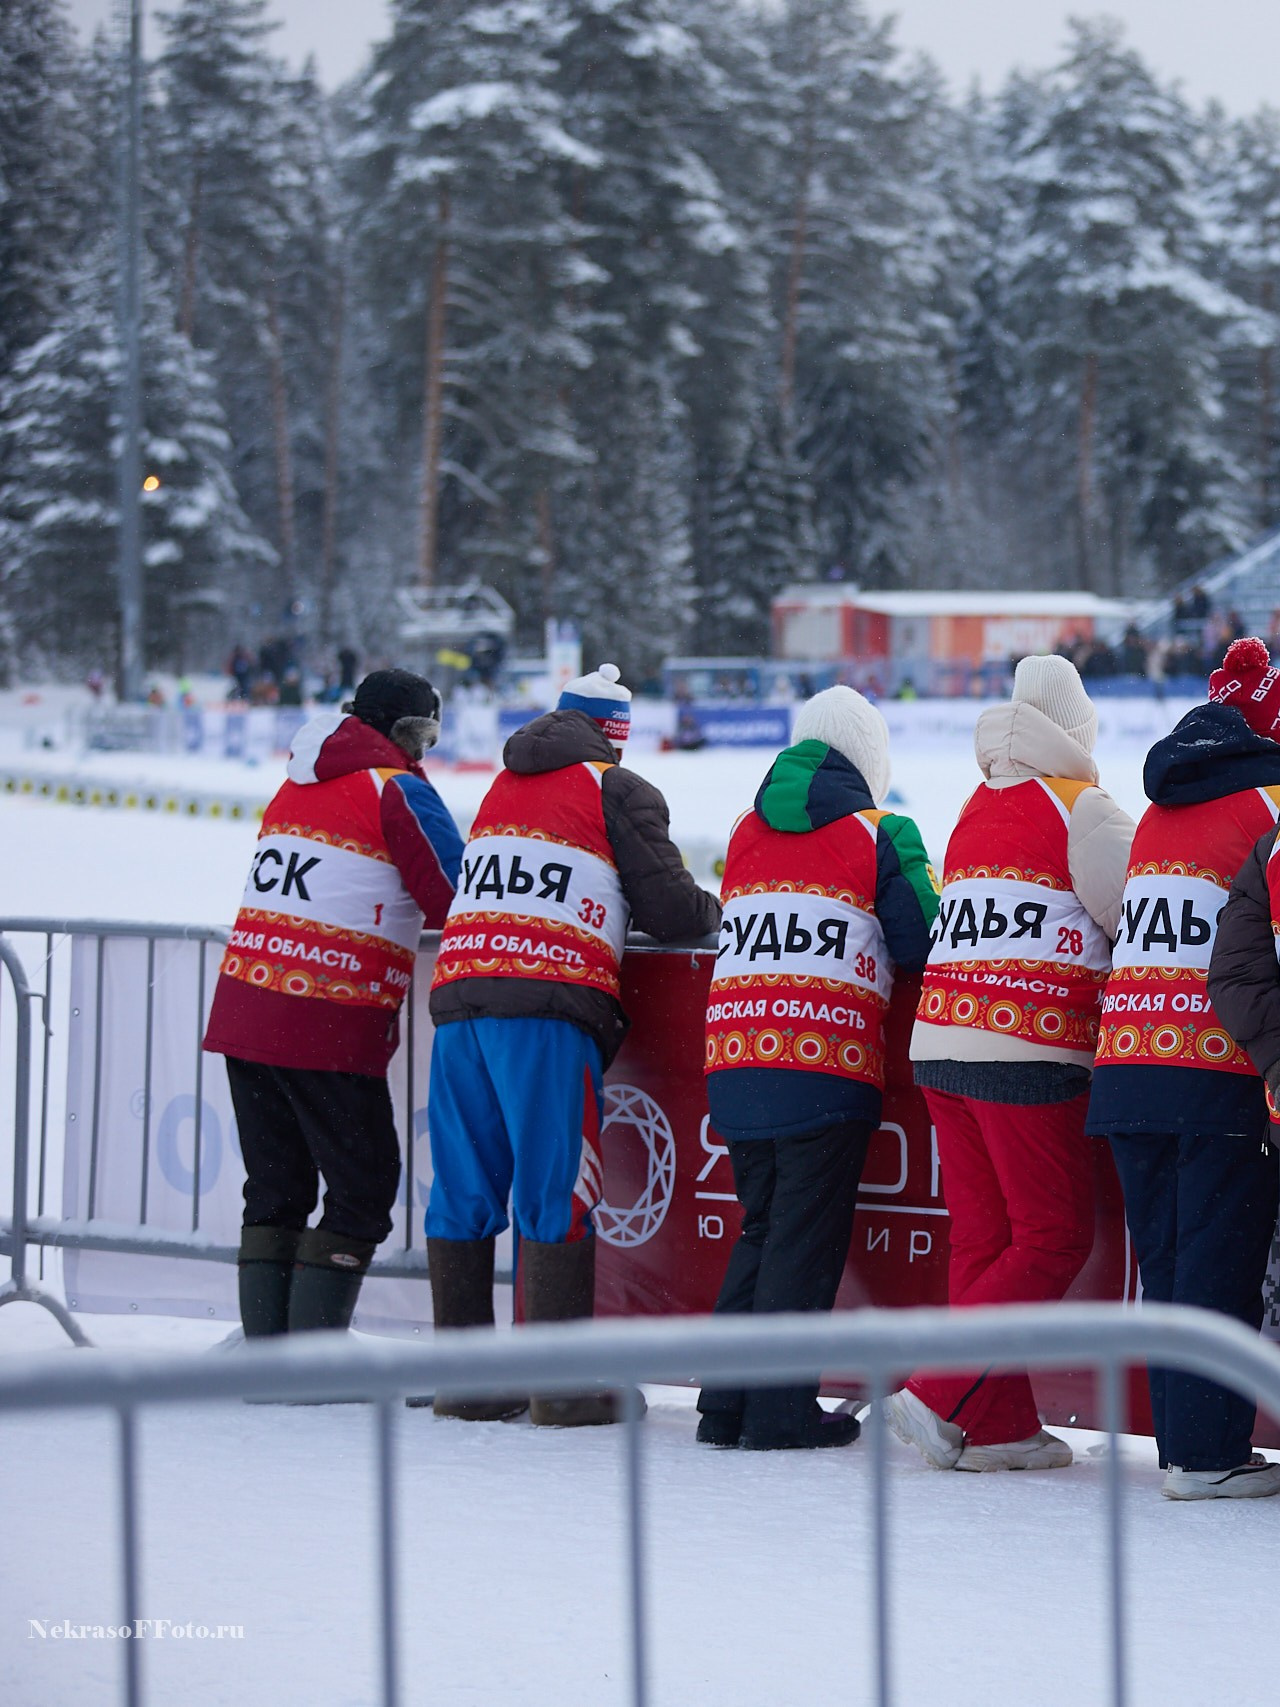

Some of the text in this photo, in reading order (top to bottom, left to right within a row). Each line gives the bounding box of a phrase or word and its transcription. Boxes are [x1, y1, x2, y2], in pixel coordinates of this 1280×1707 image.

[245, 848, 322, 901] СК
[460, 854, 573, 903] УДЬЯ
[374, 903, 384, 926] 1
[577, 897, 607, 929] 33
[929, 898, 1048, 949] УДЬЯ
[1113, 898, 1226, 953] УДЬ
[268, 936, 362, 972] ОБЛАСТЬ
[490, 934, 586, 965] ОБЛАСТЬ
[1055, 926, 1084, 956] 28
[855, 952, 877, 983] 38
[706, 999, 866, 1030] ОВСКАЯ ОБЛАСТЬ
